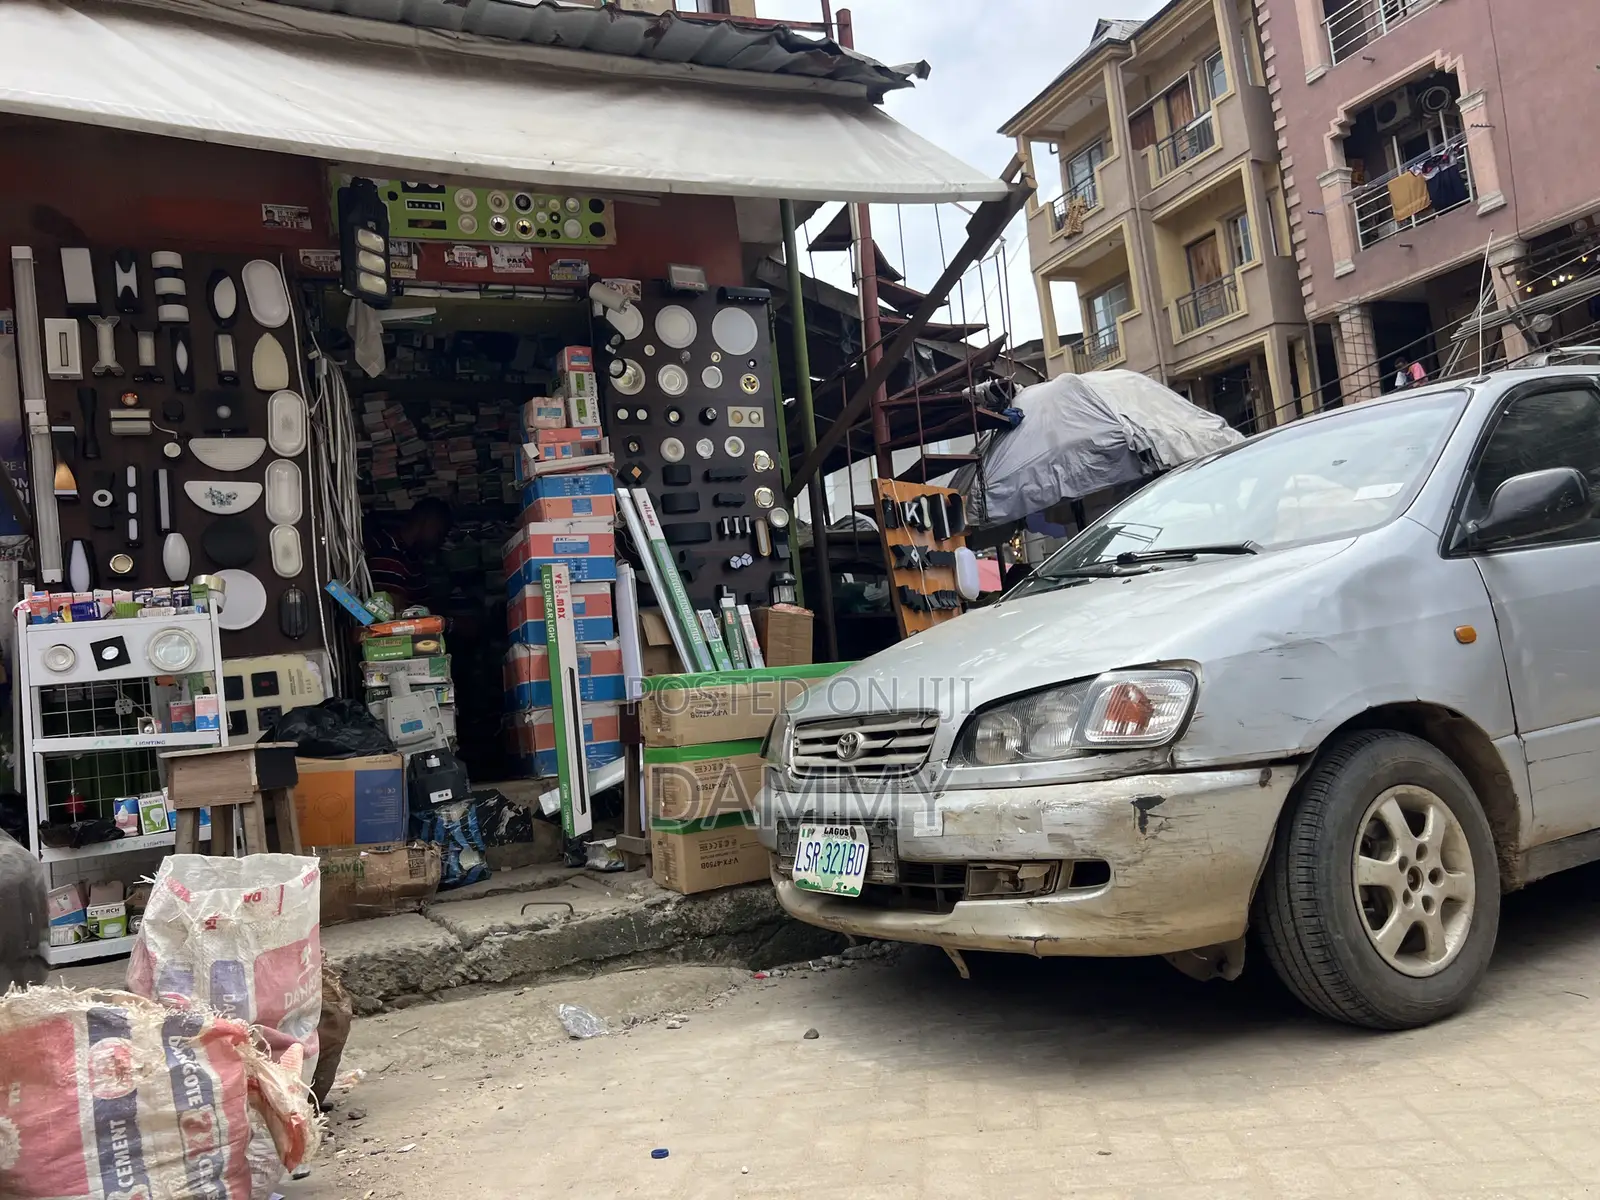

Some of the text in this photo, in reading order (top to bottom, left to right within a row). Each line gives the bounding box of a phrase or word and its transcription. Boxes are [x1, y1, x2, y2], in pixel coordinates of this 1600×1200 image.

[543, 574, 557, 643] LED LINEAR LIGHT
[823, 827, 850, 837] LAGOS
[108, 1119, 136, 1189] CEMENT
